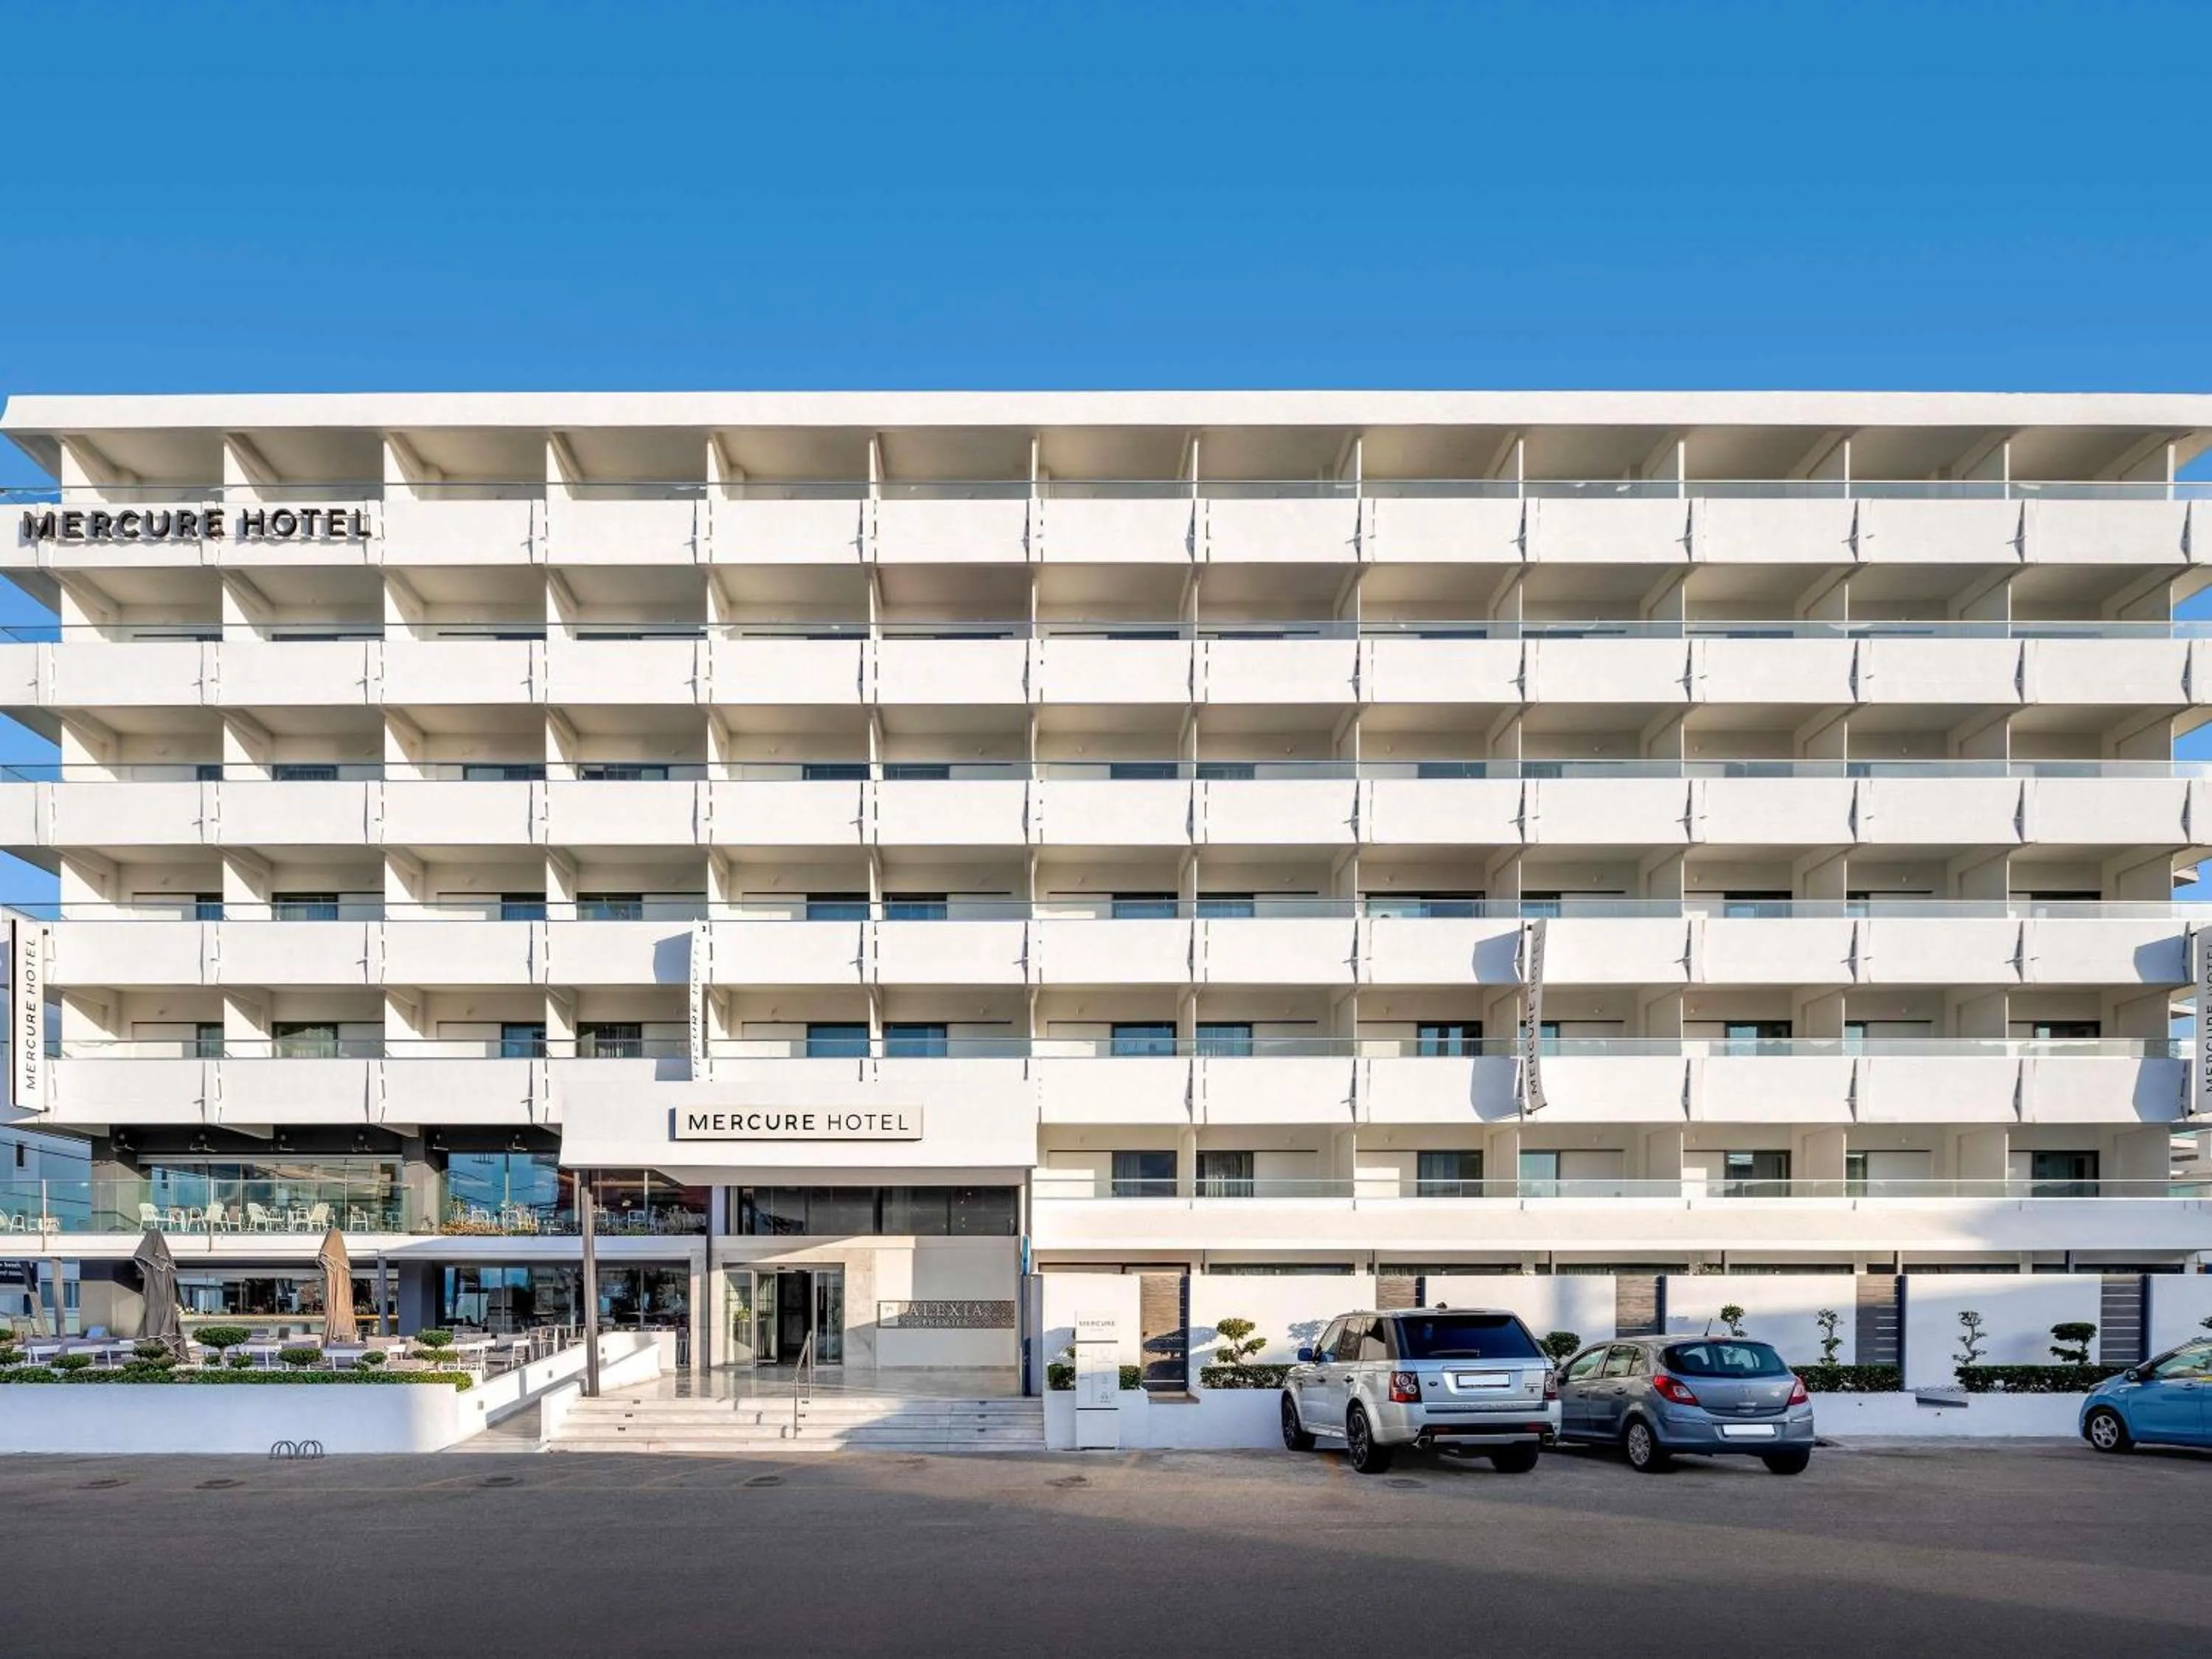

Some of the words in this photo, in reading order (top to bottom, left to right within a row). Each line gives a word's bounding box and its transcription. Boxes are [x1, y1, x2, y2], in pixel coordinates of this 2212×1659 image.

[24, 509, 224, 538] MERCURE
[243, 508, 372, 538] HOTEL
[27, 939, 36, 993] HOTEL
[27, 1001, 36, 1090] MERCURE
[1527, 1003, 1537, 1094] MERCURE
[688, 1113, 815, 1130] MERCURE
[827, 1113, 909, 1130] HOTEL
[910, 1303, 983, 1316] ALEXIA
